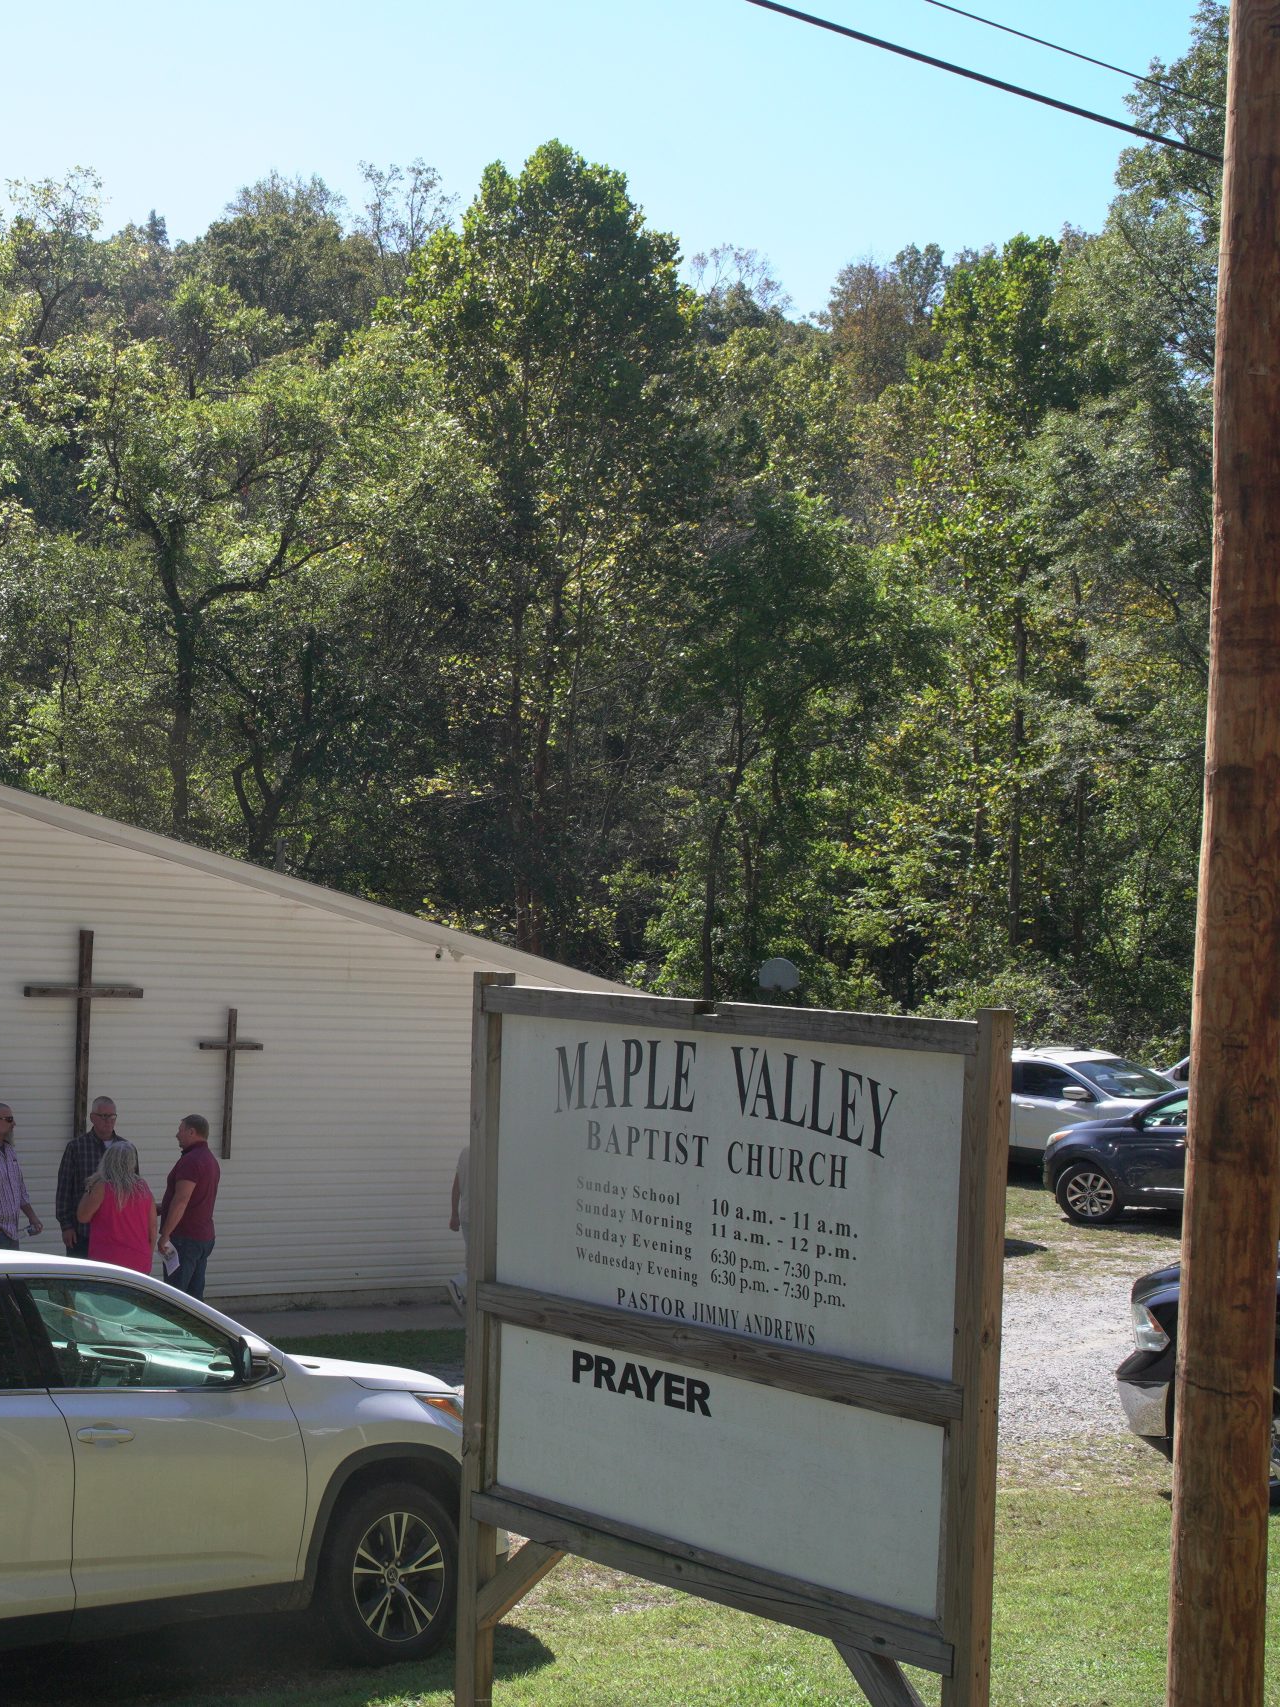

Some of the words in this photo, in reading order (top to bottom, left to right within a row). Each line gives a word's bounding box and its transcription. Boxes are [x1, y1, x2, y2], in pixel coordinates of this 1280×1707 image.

[554, 1039, 697, 1113] MAPLE
[731, 1046, 898, 1159] VALLEY
[586, 1120, 709, 1168] BAPTIST
[727, 1141, 848, 1190] CHURCH
[576, 1176, 628, 1199] Sunday
[632, 1185, 680, 1206] School
[712, 1198, 729, 1218] 10
[735, 1206, 773, 1225] a.m.
[793, 1211, 809, 1231] 11
[817, 1219, 858, 1239] a.m.
[576, 1199, 626, 1222] Sunday
[631, 1208, 693, 1235] Morning
[711, 1223, 727, 1238] 11
[733, 1229, 771, 1246] a.m.
[791, 1236, 809, 1252] 12
[816, 1243, 857, 1261] p.m.
[576, 1223, 627, 1247] Sunday
[632, 1233, 692, 1261] Evening
[710, 1248, 736, 1267] 6:30
[740, 1257, 770, 1273] p.m.
[783, 1260, 810, 1280] 7:30
[814, 1270, 846, 1287] p.m.
[576, 1247, 643, 1275] Wednesday
[647, 1261, 698, 1287] Evening
[710, 1268, 736, 1287] 6:30
[740, 1277, 769, 1294] p.m.
[783, 1282, 810, 1301] 7:30
[813, 1291, 846, 1308] p.m.
[617, 1287, 686, 1319] PASTOR
[692, 1302, 740, 1330] JIMMY
[743, 1314, 815, 1346] ANDREWS
[572, 1349, 712, 1418] PRAYER
